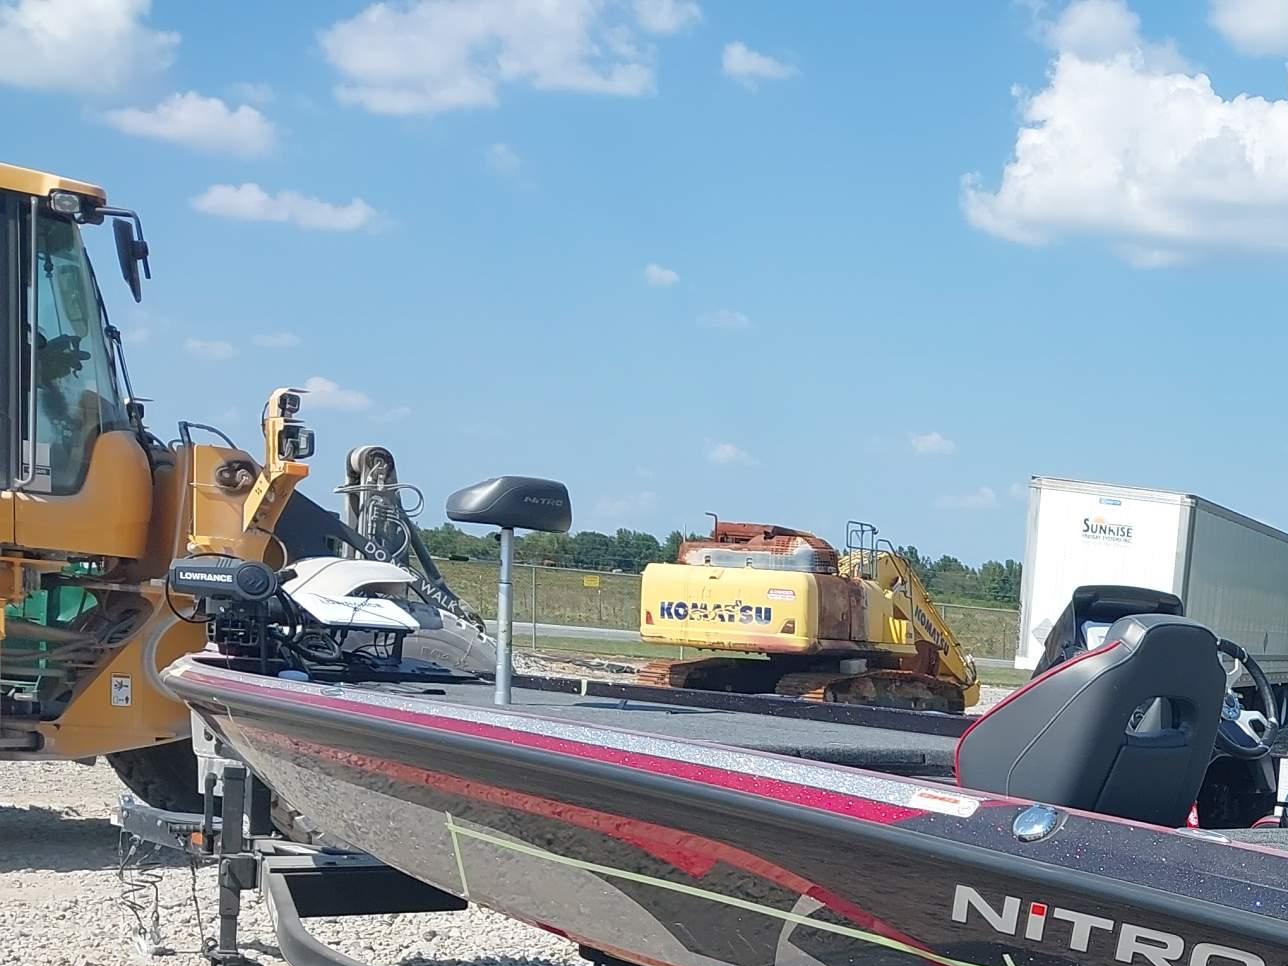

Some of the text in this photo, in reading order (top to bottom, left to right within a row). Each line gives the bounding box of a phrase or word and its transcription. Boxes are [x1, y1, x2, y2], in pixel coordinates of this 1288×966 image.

[1082, 518, 1132, 537] SUNRISE
[179, 570, 233, 583] LOWRANCE
[364, 541, 459, 613] DO WALK
[660, 600, 772, 625] KOMATSU
[914, 605, 951, 655] KOMATSU
